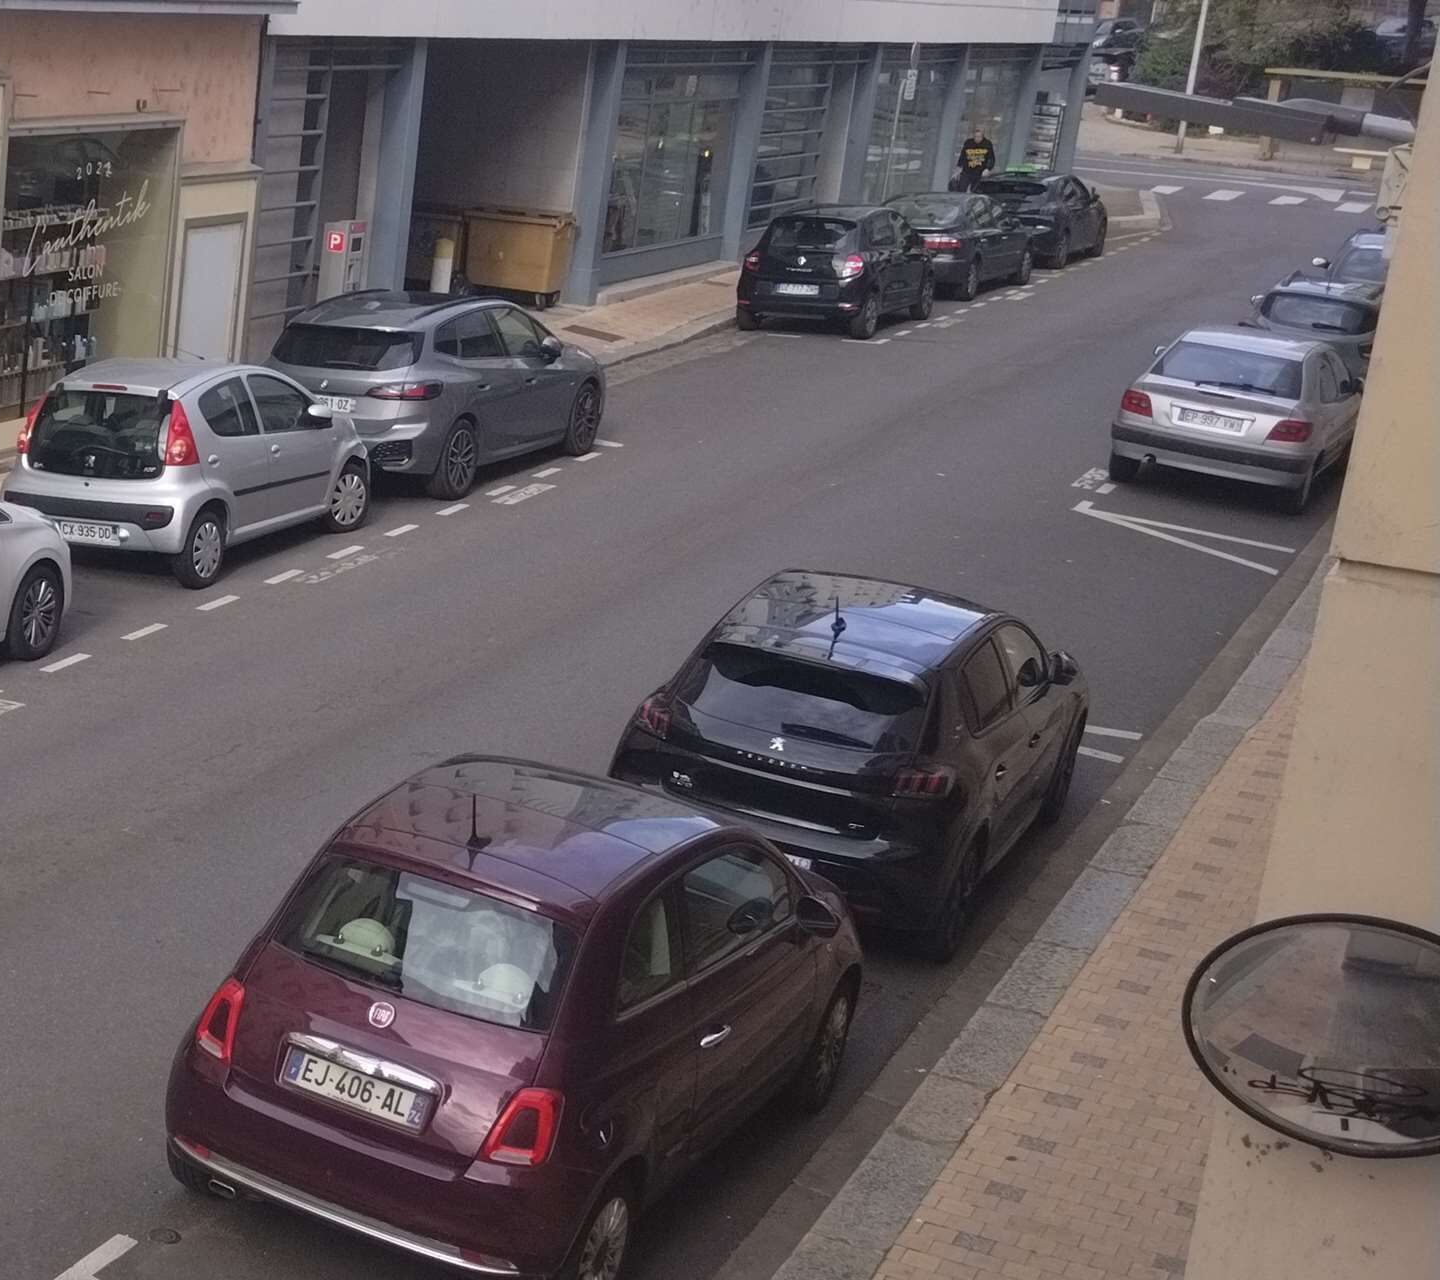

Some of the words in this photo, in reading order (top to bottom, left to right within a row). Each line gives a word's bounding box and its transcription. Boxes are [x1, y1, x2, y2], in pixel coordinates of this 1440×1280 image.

[330, 233, 342, 249] P
[68, 264, 104, 282] SALON
[66, 281, 120, 305] COIFFURE
